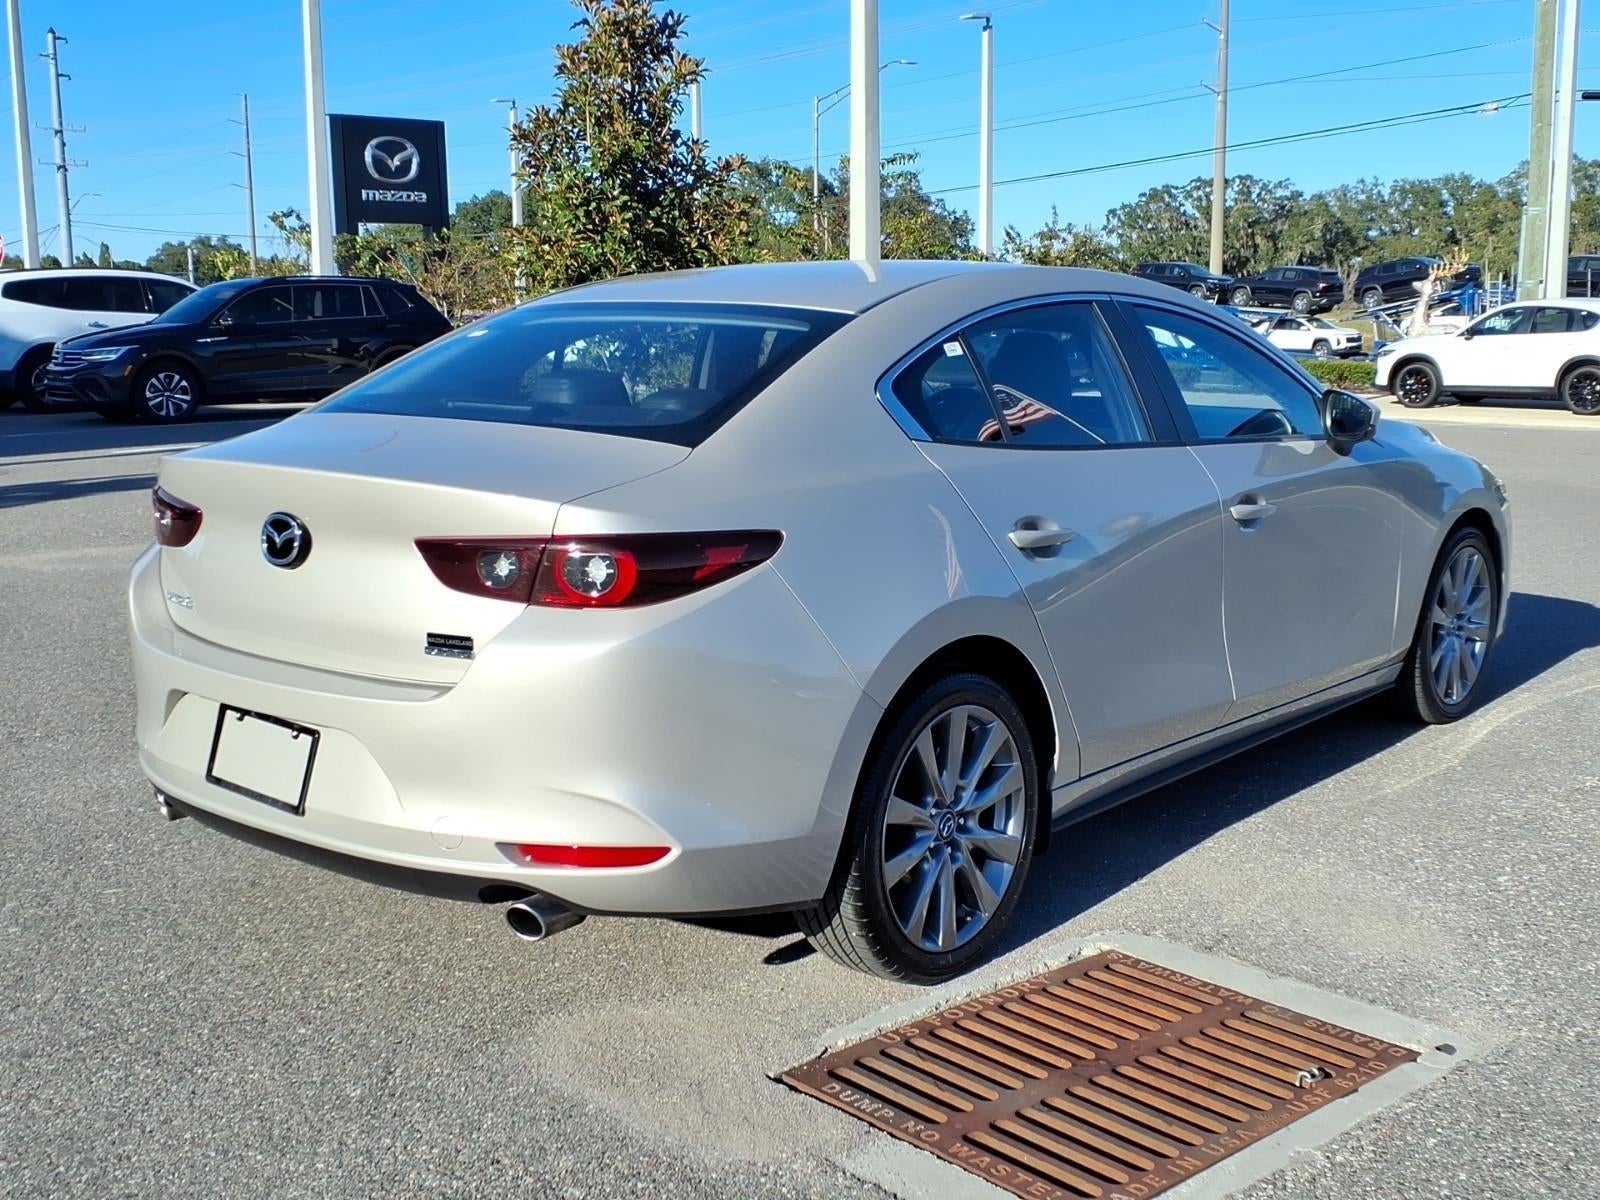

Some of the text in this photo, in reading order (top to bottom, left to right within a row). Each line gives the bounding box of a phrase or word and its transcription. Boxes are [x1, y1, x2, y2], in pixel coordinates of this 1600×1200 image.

[361, 189, 427, 203] mazda
[877, 975, 1048, 1044] US FOUNDRY
[1106, 951, 1408, 1058] DRAINS TO WATERWAYS
[1285, 1060, 1389, 1112] USF 6210
[900, 1119, 941, 1142] NO
[1167, 1154, 1196, 1176] IN
[1201, 1128, 1258, 1156] USA
